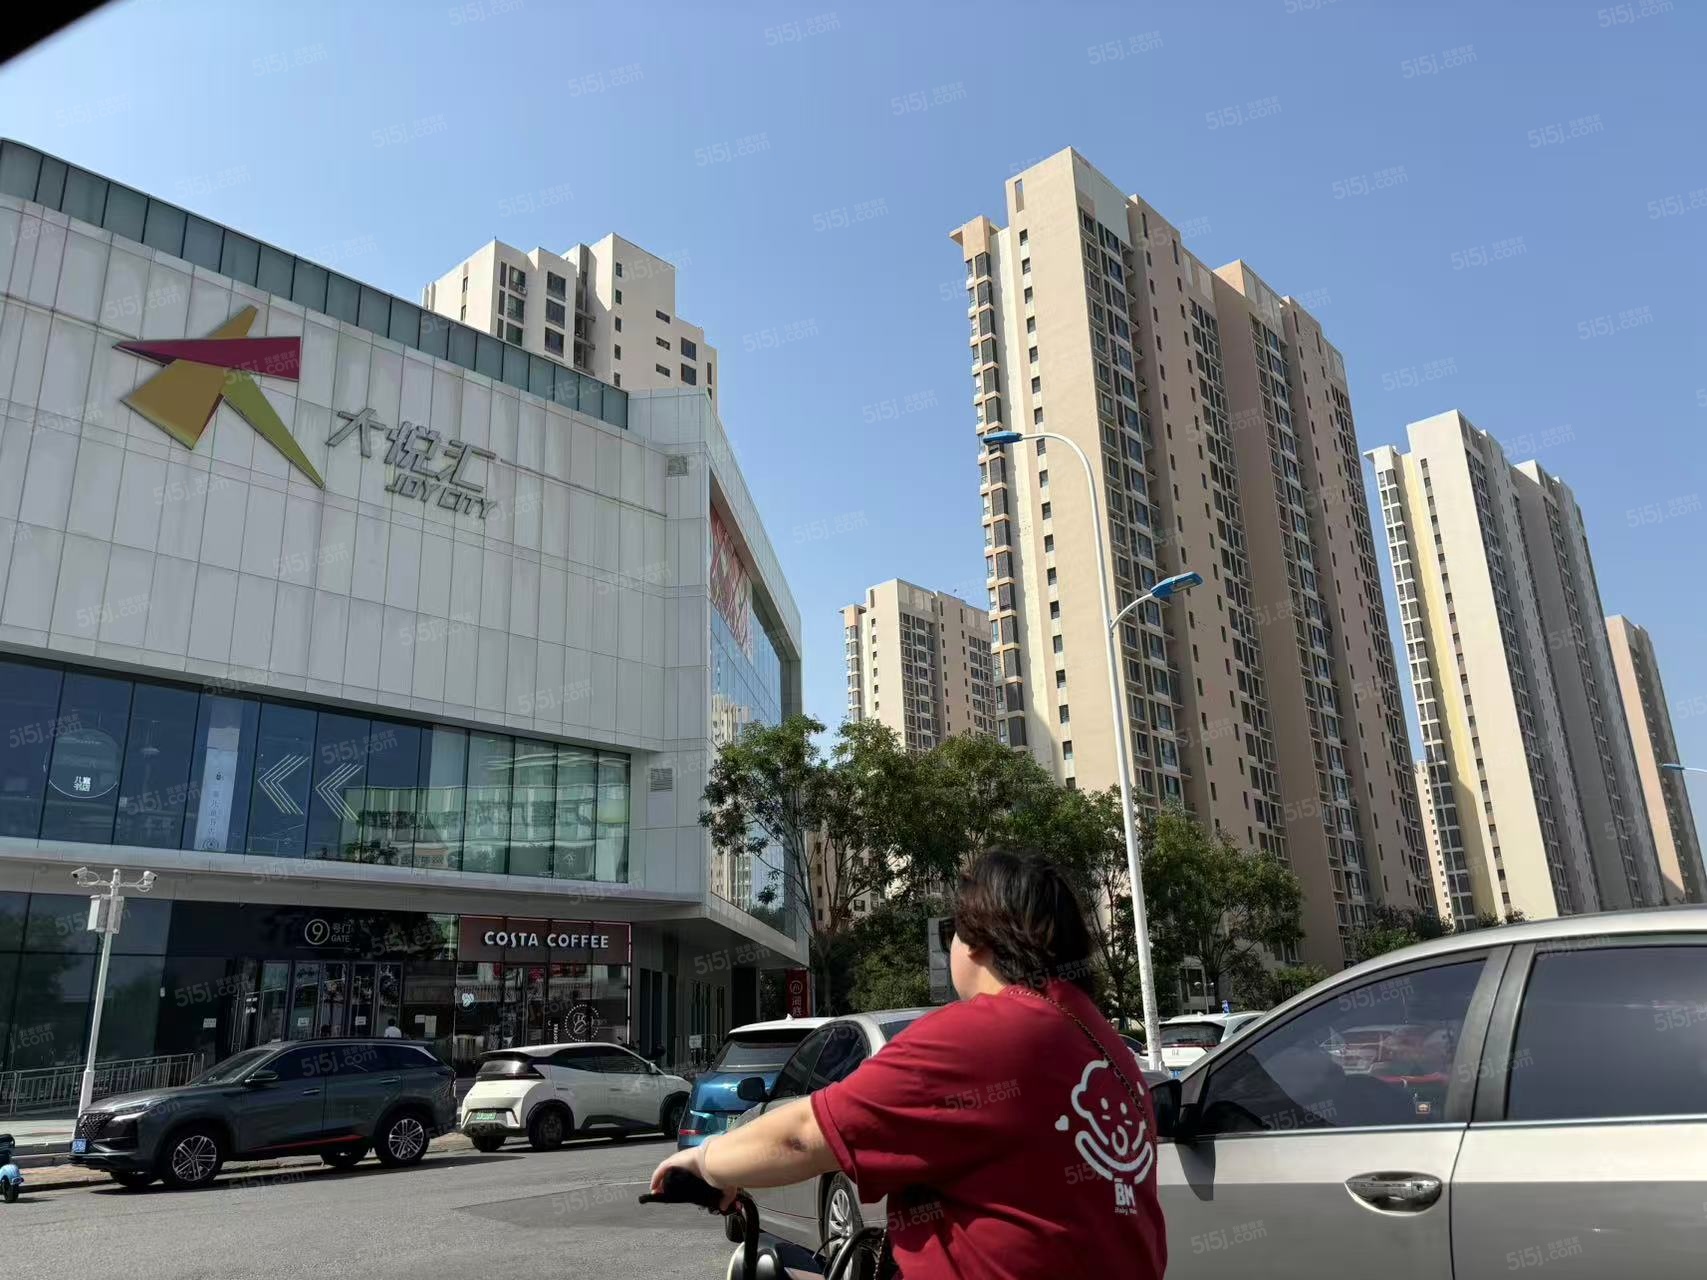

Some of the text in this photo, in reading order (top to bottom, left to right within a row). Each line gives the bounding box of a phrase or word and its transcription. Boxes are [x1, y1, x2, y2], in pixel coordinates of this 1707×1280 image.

[325, 408, 496, 493] 大悦汇
[384, 473, 498, 519] JOY CITY
[331, 934, 350, 943] GATE
[484, 931, 609, 948] COSTA COFFEE
